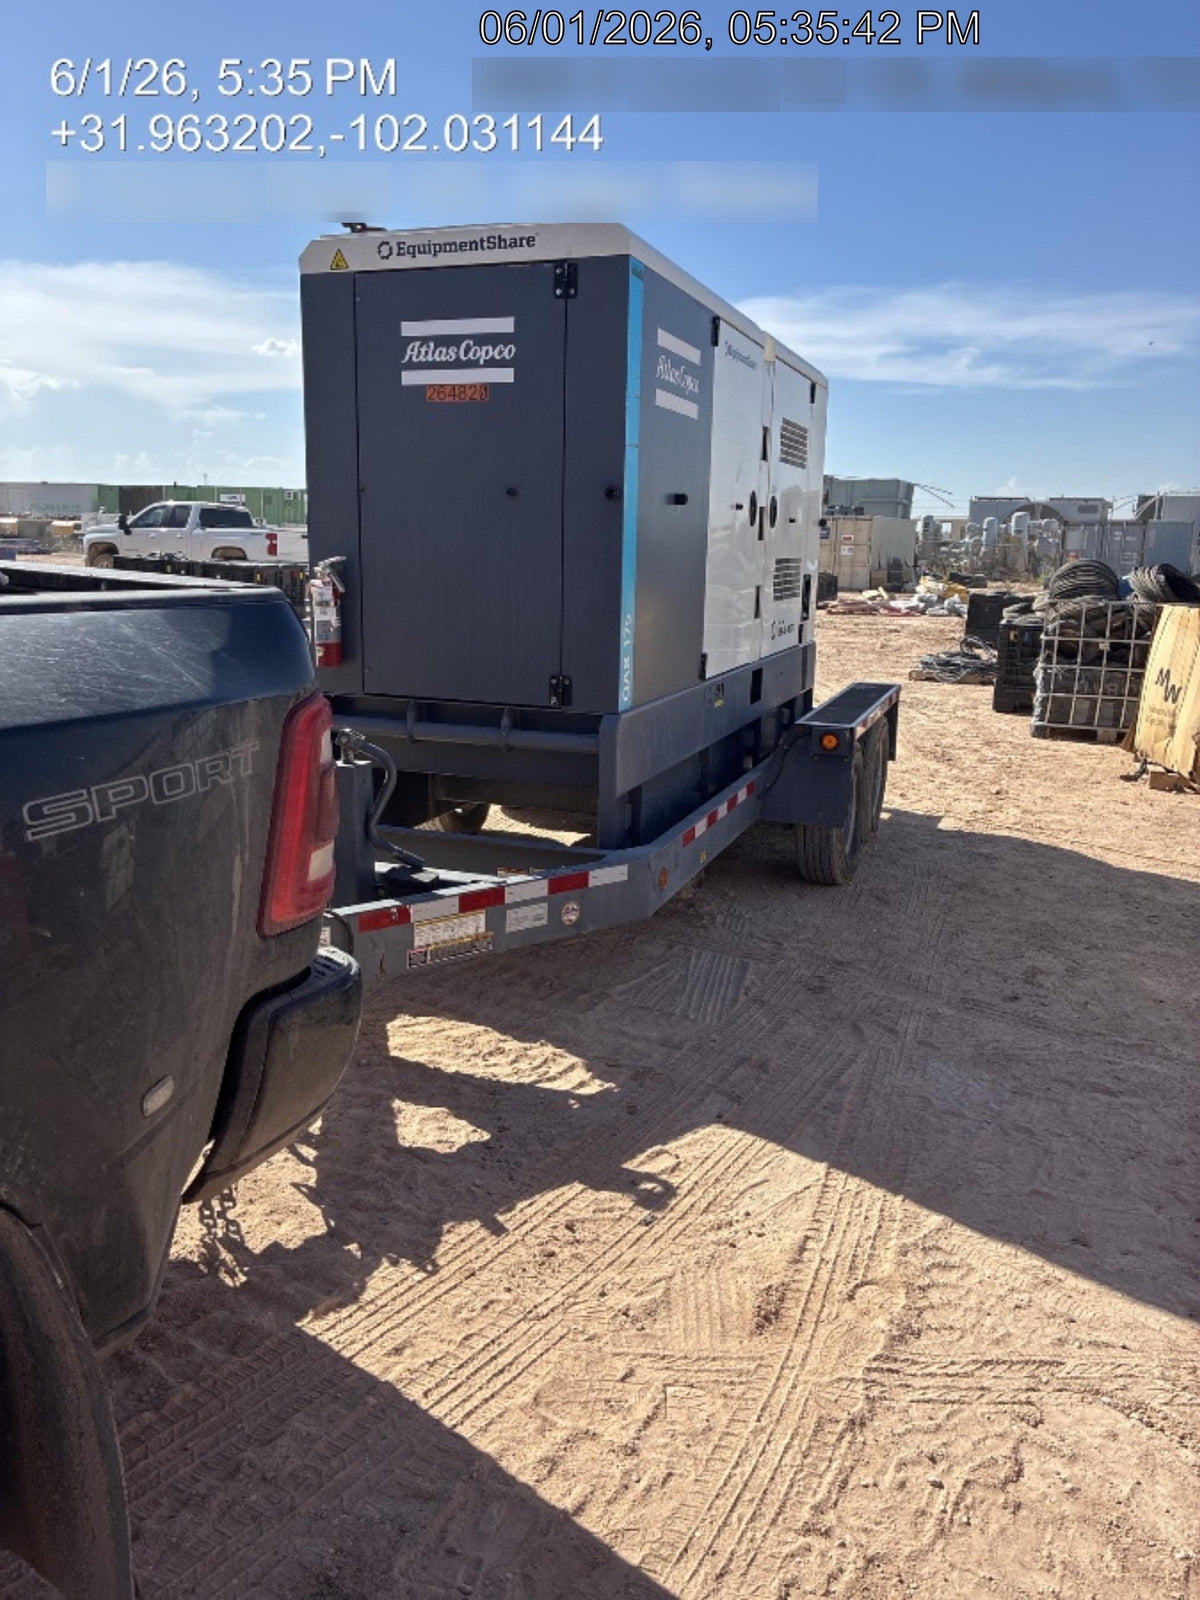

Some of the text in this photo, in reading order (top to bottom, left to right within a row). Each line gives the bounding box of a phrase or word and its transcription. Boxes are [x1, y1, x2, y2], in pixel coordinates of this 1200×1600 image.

[395, 233, 536, 259] EquipmentShare
[401, 338, 517, 365] Atlas Copco
[22, 740, 260, 842] SPORT
